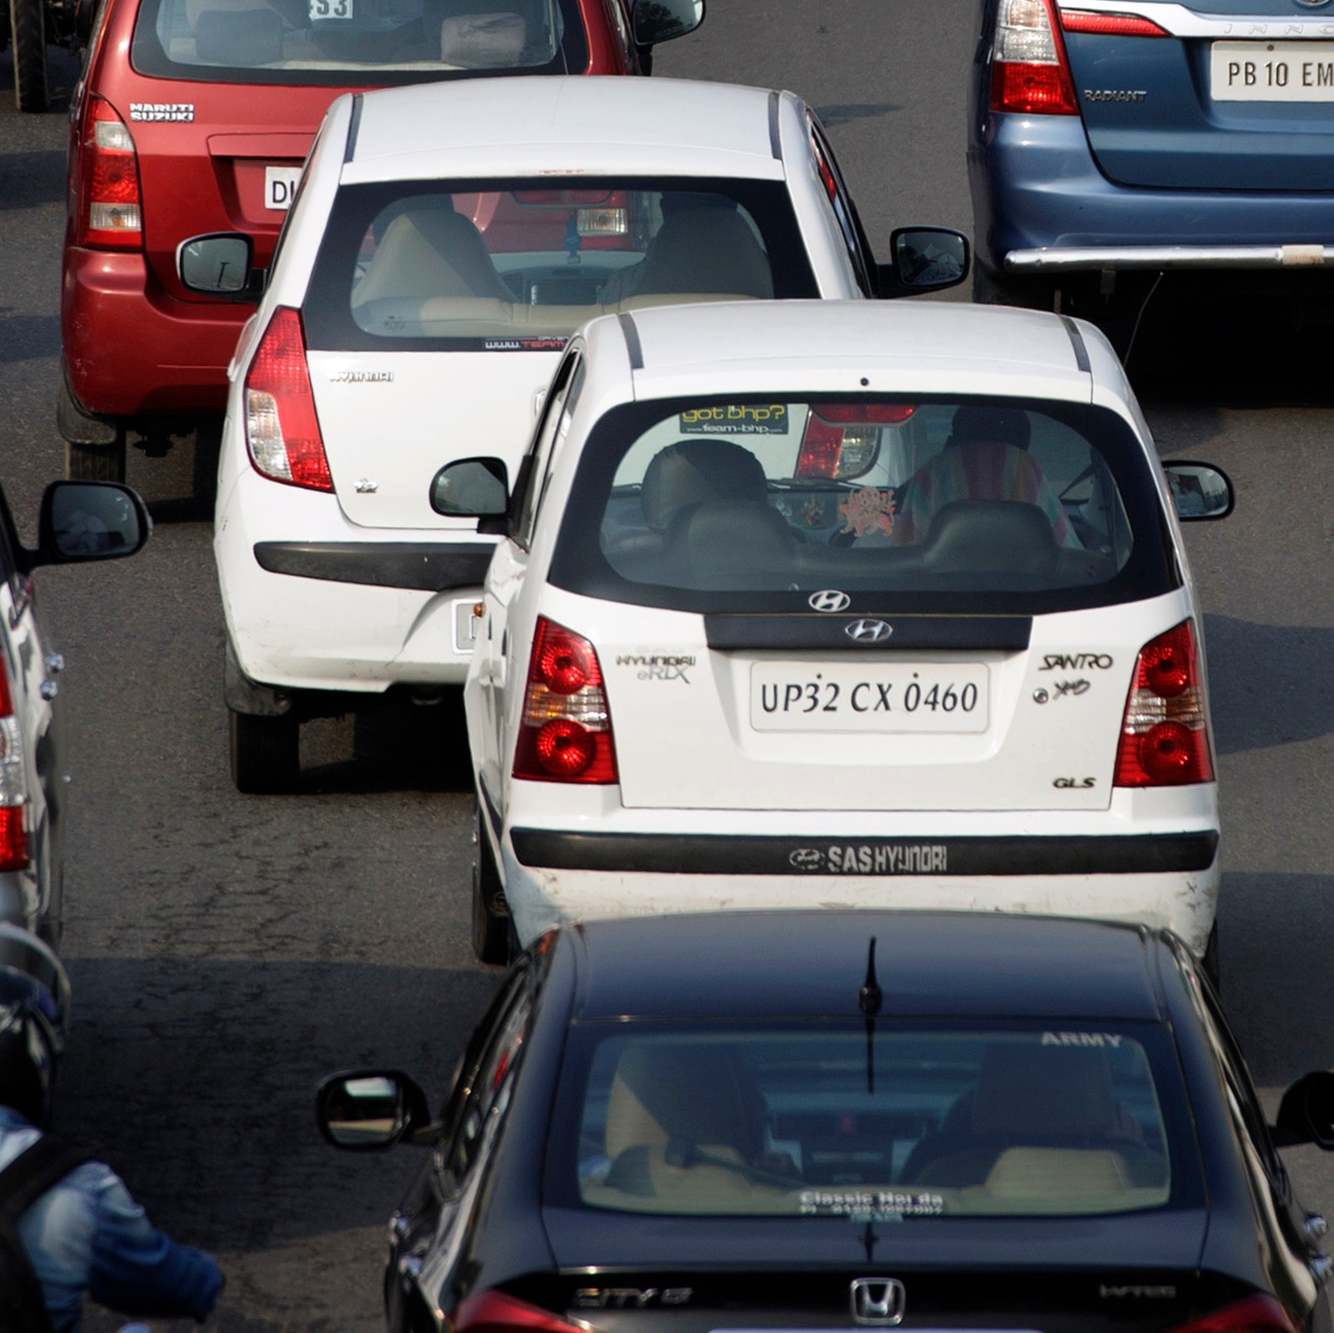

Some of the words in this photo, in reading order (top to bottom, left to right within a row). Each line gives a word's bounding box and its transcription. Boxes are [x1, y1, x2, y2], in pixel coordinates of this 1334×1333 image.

[1228, 62, 1257, 88] PB
[1265, 62, 1288, 88] 10
[1302, 63, 1334, 88] EM
[1083, 88, 1148, 103] RADIANT
[129, 103, 195, 113] MARUTI
[130, 112, 195, 123] SUZUKI
[328, 371, 395, 384] HYUNDAI
[682, 407, 724, 424] got
[727, 404, 786, 423] bhp?
[616, 654, 697, 667] HYUNDAI
[1038, 653, 1114, 672] SANTRO
[762, 682, 840, 714] UP32
[850, 682, 893, 713] CX
[903, 682, 979, 714] 0460
[1052, 776, 1097, 789] GLS
[828, 846, 873, 872] SAS
[873, 845, 948, 872] HYUNDAI
[1040, 1031, 1124, 1048] ARMY
[799, 1190, 873, 1205] Classic
